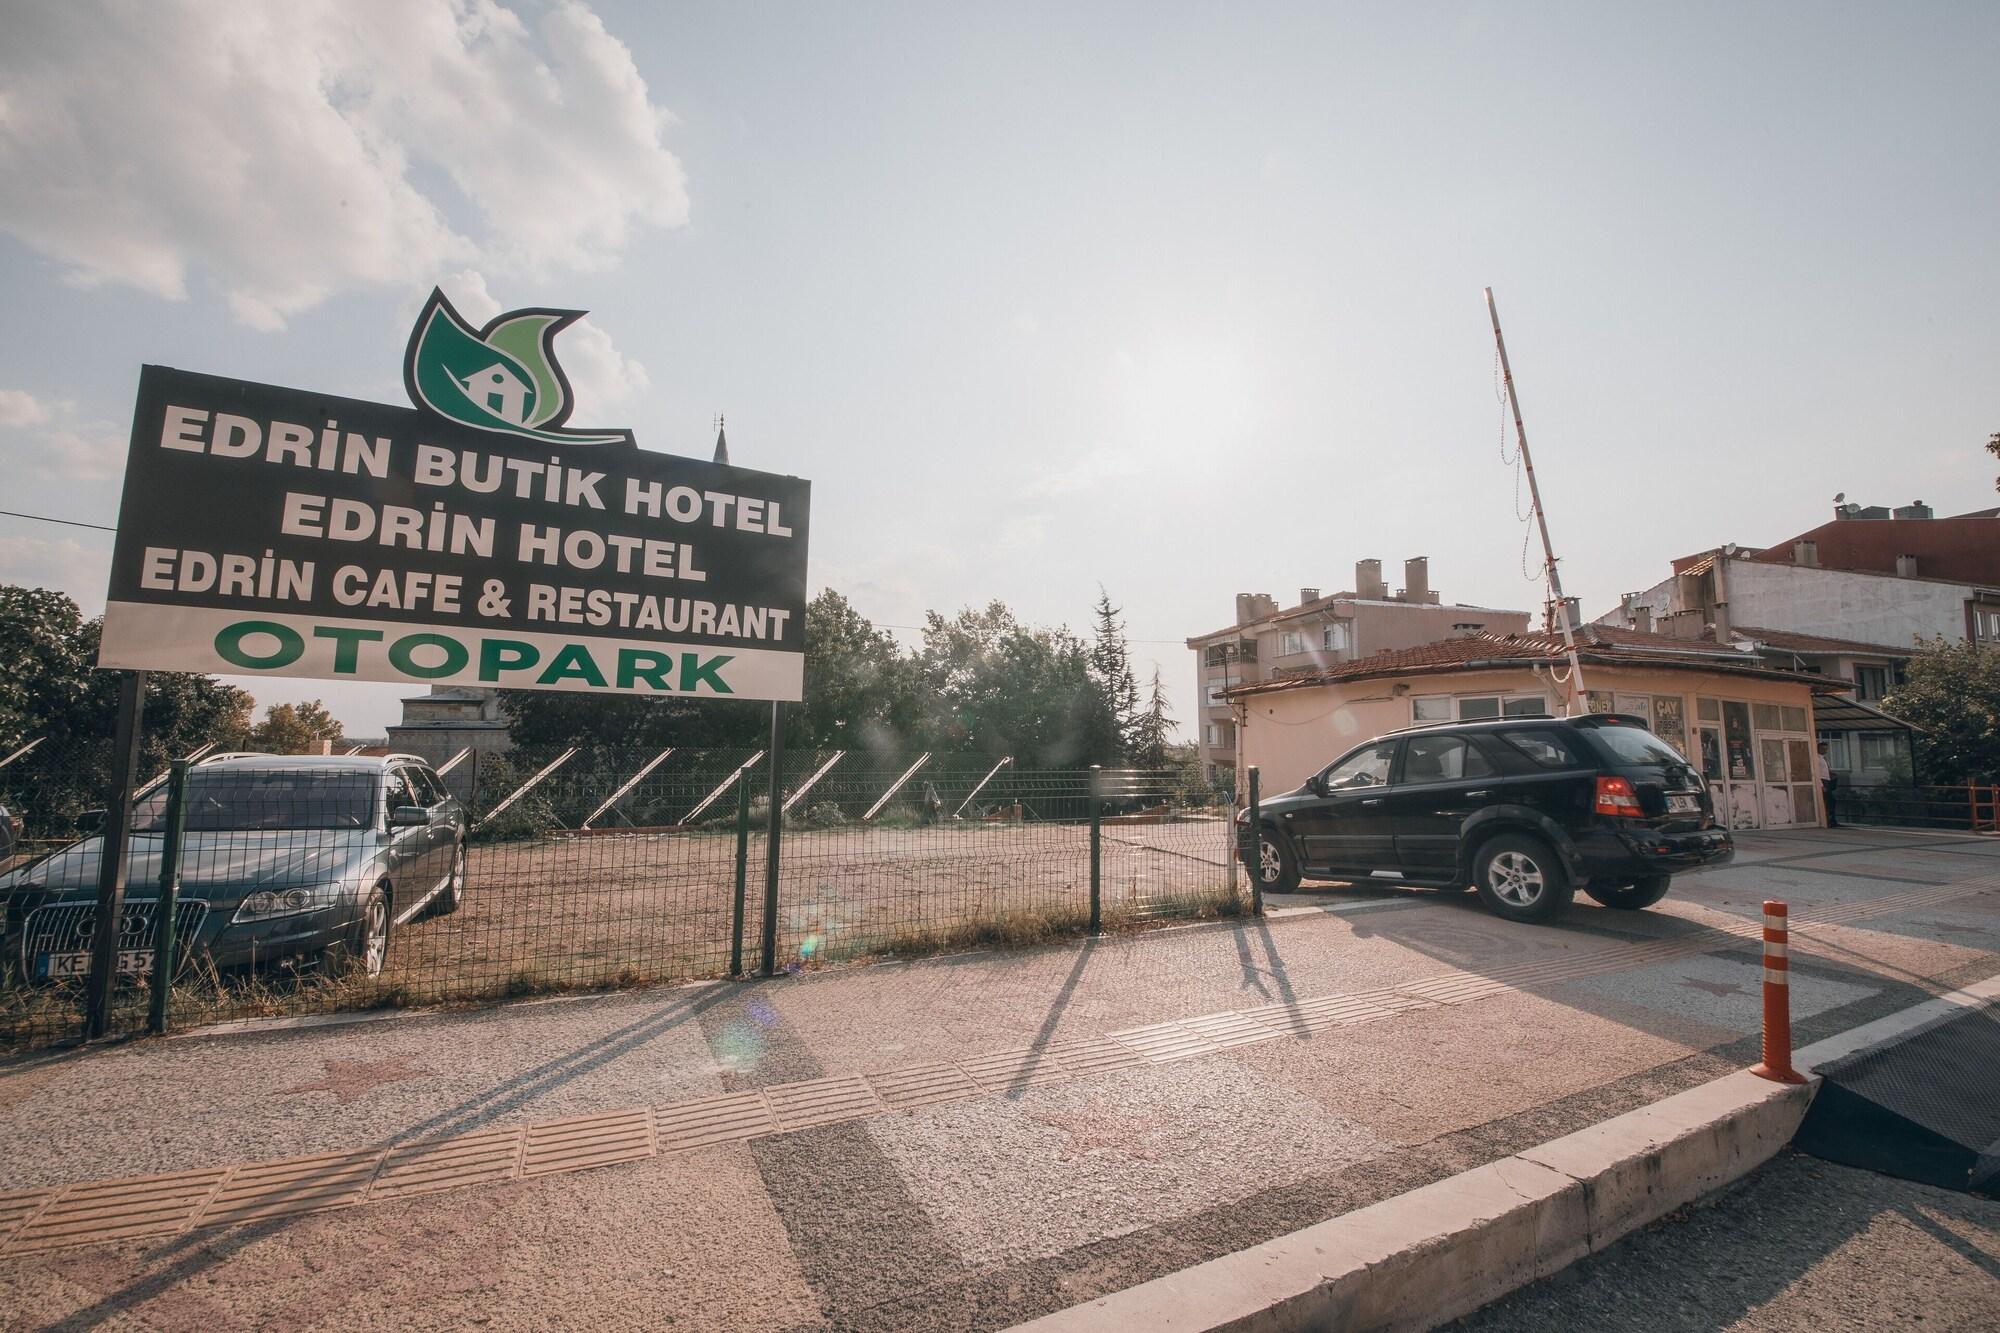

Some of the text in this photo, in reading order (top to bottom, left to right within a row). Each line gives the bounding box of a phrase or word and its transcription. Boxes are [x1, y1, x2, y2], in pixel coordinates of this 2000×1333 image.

[160, 405, 793, 538] EDRİN BUTİK HOTEL
[281, 492, 707, 582] EDRİN HOTEL
[141, 546, 790, 641] EDRİN CAFE & RESTAURANT
[214, 620, 735, 694] OTOPARK
[1656, 700, 1677, 717] ÇAY
[57, 954, 86, 973] KE
